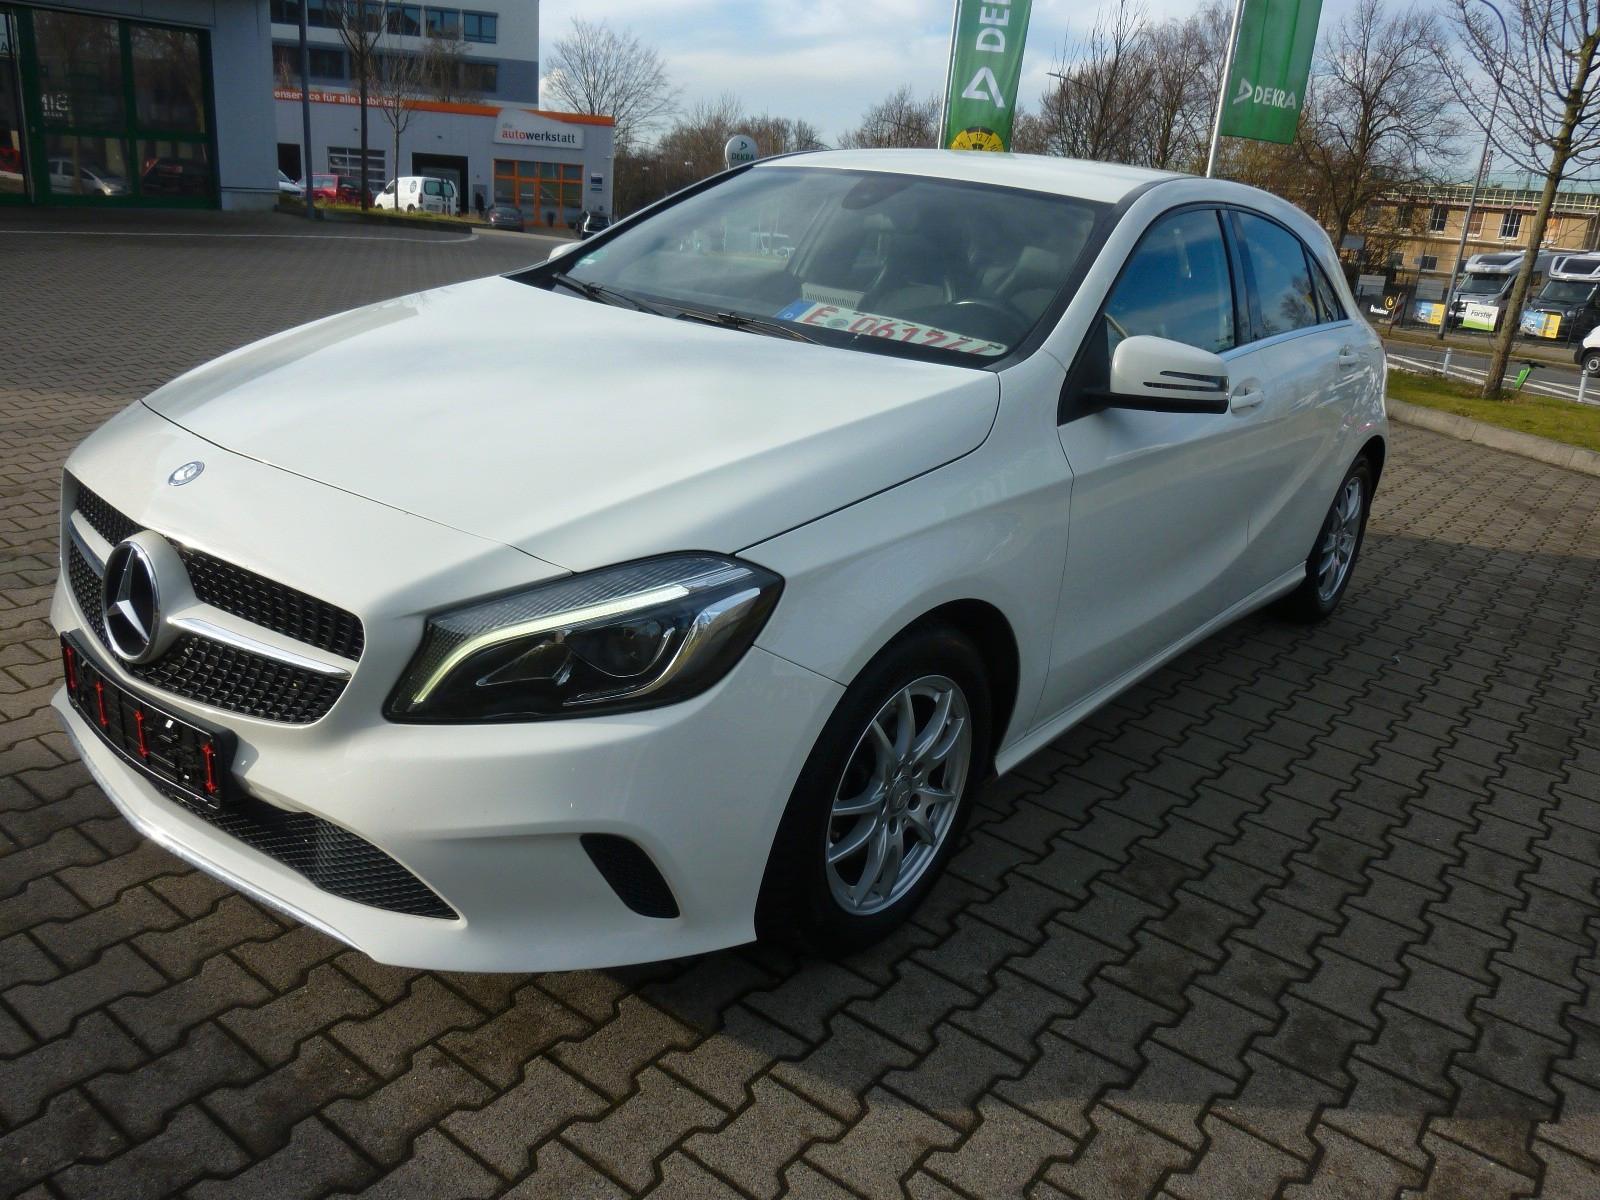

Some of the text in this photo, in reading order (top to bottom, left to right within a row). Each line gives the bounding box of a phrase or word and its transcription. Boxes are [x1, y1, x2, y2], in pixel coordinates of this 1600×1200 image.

[976, 0, 1011, 53] DE
[339, 94, 356, 104] alle
[1253, 85, 1297, 109] DEKRA
[502, 129, 576, 144] autowerkstatt
[731, 152, 755, 161] DEKRA
[803, 305, 839, 325] E
